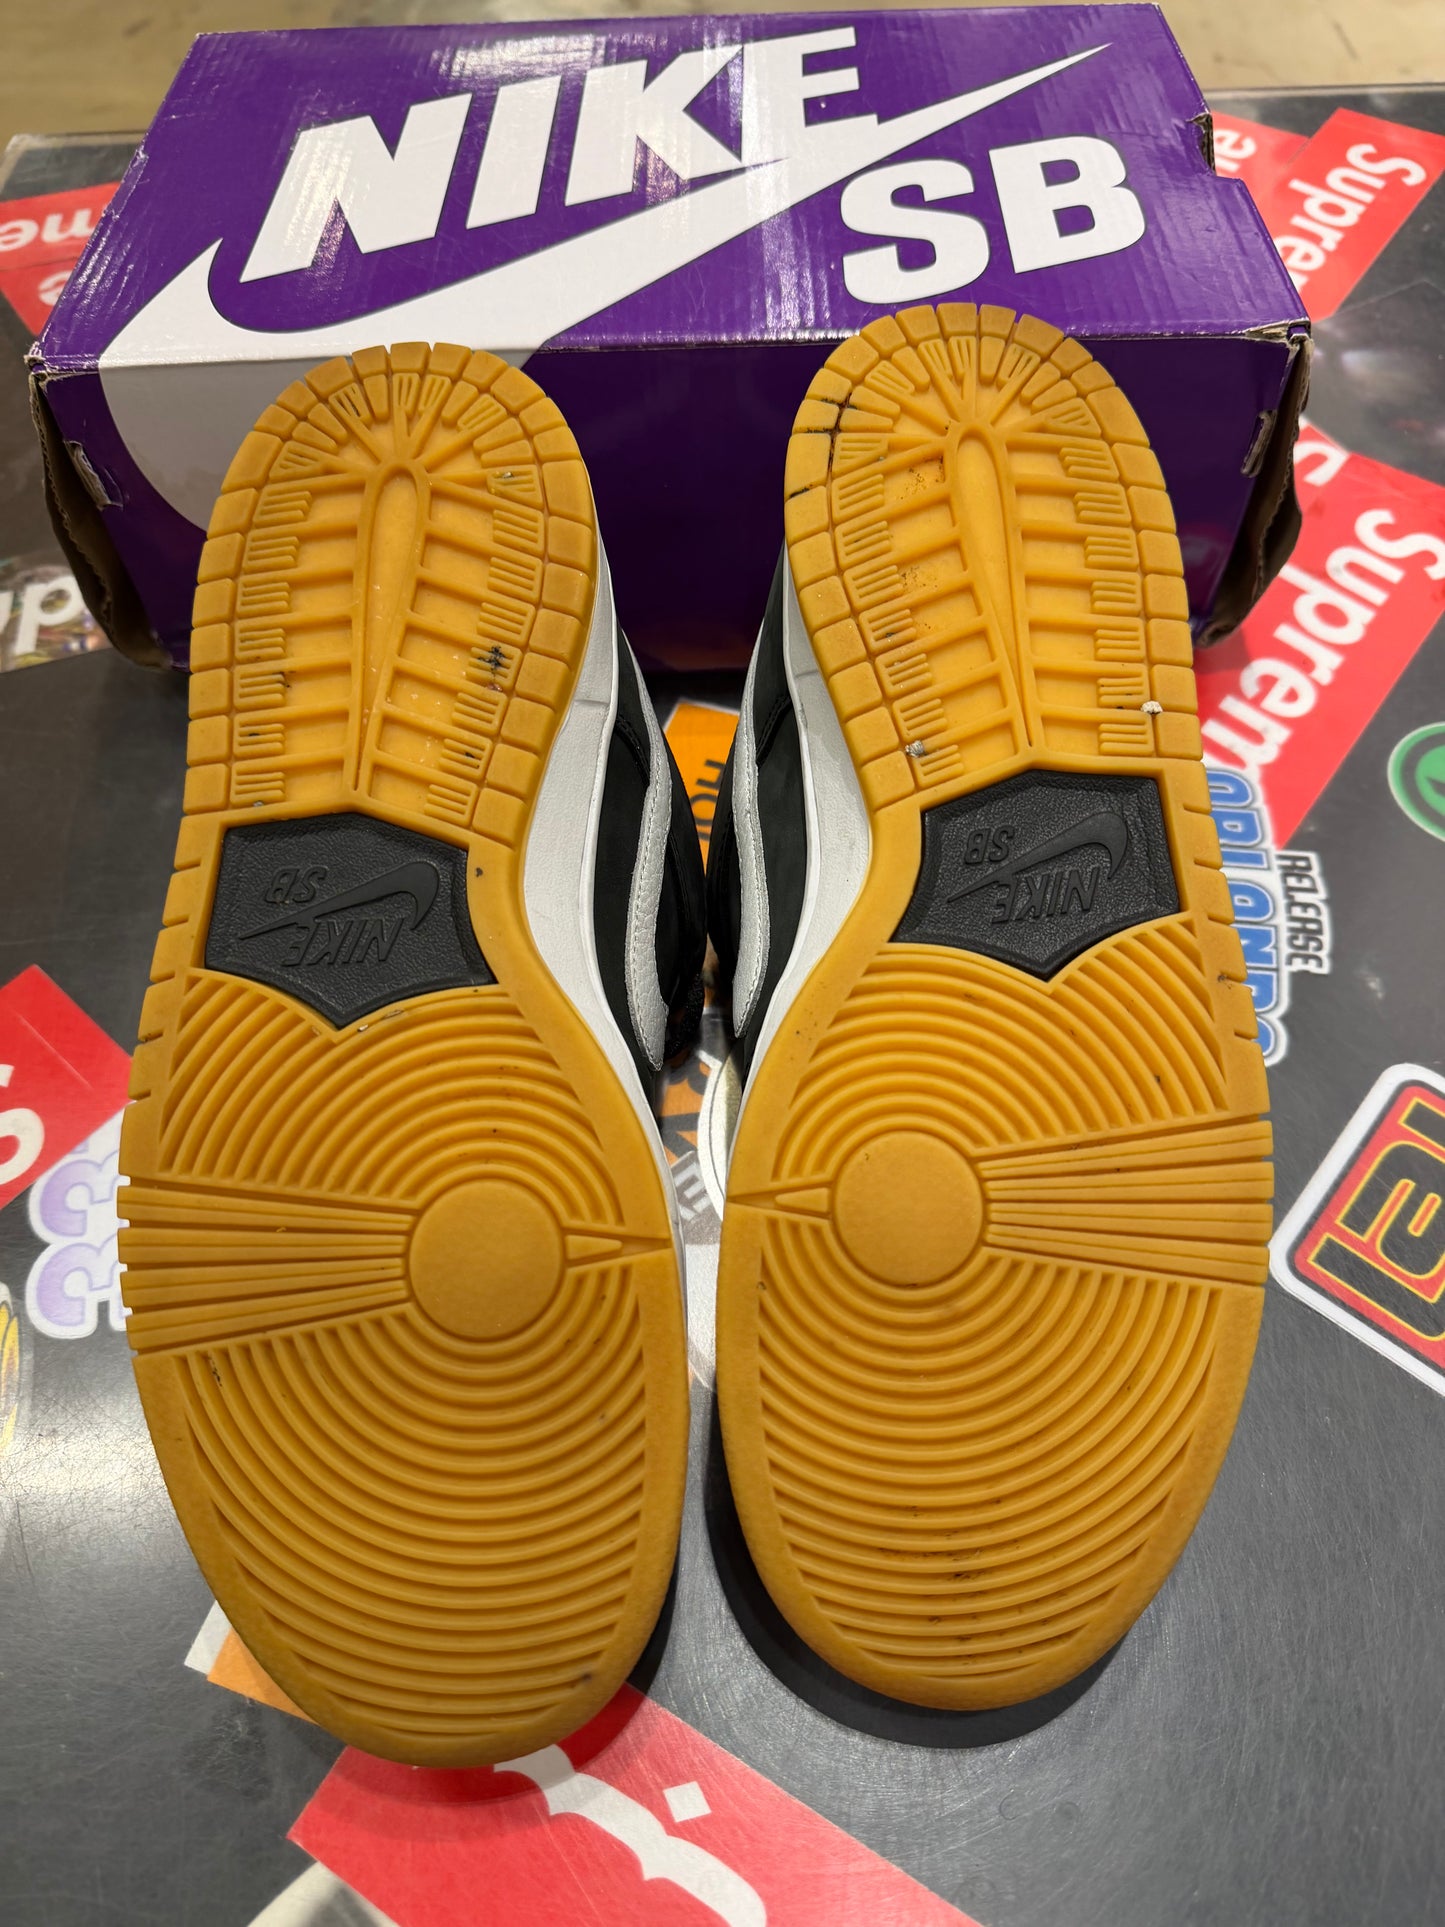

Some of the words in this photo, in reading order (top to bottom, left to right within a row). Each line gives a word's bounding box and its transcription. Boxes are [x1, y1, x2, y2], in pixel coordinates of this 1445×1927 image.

[239, 26, 878, 283] NIKE
[841, 135, 1146, 304] SB
[1273, 143, 1427, 289] Supre
[264, 866, 328, 903] SB
[964, 825, 1014, 865] SB
[991, 866, 1099, 924] NIKE
[1276, 853, 1324, 971] RELEASE
[281, 916, 404, 967] NIKE
